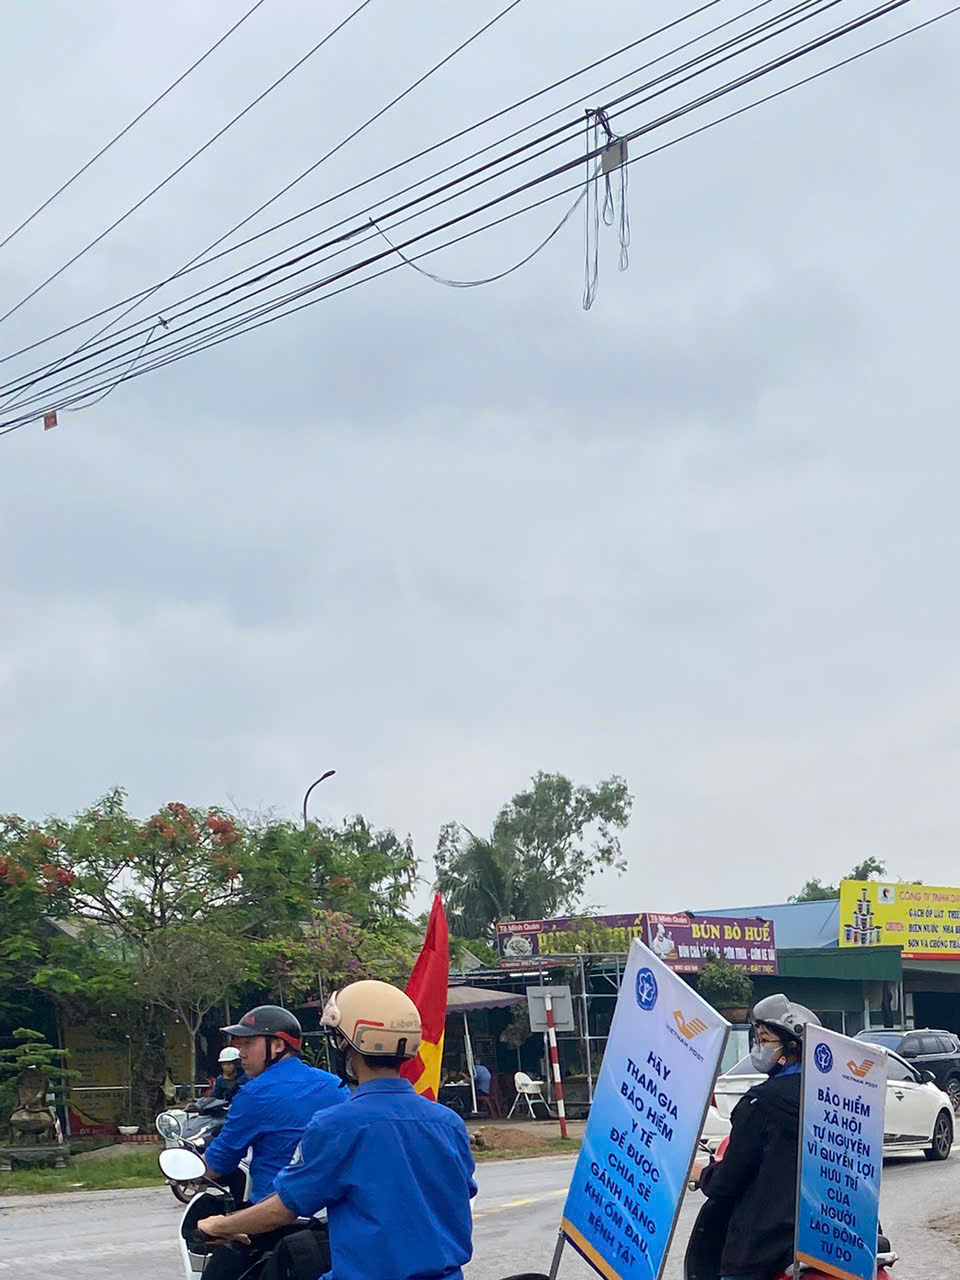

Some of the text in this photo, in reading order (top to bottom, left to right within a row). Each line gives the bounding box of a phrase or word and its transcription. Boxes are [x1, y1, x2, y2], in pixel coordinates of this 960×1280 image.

[691, 920, 771, 941] BÚN BÒ HUẾ
[647, 1050, 671, 1081] HÃY
[626, 1058, 678, 1120] THAM GIA
[817, 1087, 870, 1118] BẢO HIỂM
[621, 1081, 674, 1142] BẢO HIỂM
[824, 1109, 861, 1136] XÃ HỘI
[631, 1118, 657, 1149] Y TẾ
[813, 1124, 870, 1158] TỰ NGUYỆN
[609, 1127, 660, 1183] ĐỂ ĐƯỢC
[807, 1140, 875, 1180] VÌ QUYỀN LỢI
[608, 1153, 652, 1202] CHIA SẺ
[820, 1165, 859, 1192] HƯU TRÍ
[584, 1181, 603, 1206] KHI
[604, 1201, 623, 1228] ỐM
[590, 1162, 656, 1235] GÁNH NẶNG
[827, 1186, 850, 1207] CỦA
[821, 1203, 856, 1227] NGƯỜI
[588, 1211, 636, 1268] BỆNH TẤT
[809, 1217, 864, 1249] LAO ĐỘNG
[821, 1239, 852, 1262] TỰ DO
